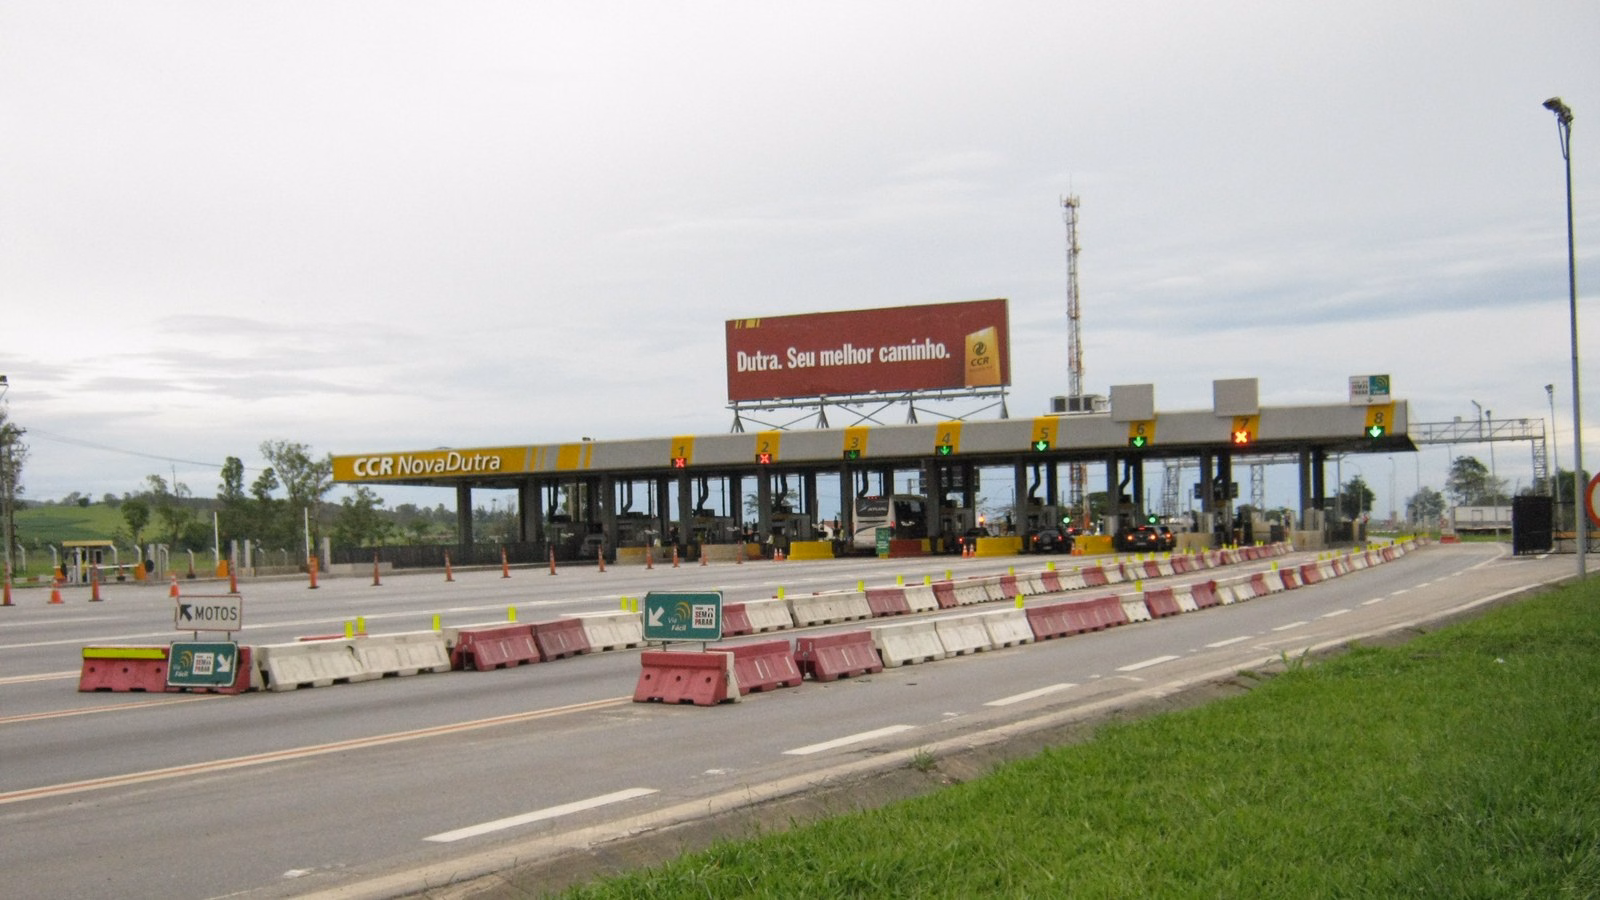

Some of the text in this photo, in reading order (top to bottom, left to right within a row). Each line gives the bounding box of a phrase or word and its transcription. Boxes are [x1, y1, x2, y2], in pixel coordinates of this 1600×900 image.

[737, 338, 951, 372] Dutra. Seu melhor caminho.
[971, 357, 990, 367] CCR
[1240, 416, 1250, 429] 7
[1374, 412, 1384, 424] 8
[1040, 427, 1050, 440] 5
[1136, 423, 1145, 436] 6
[851, 437, 859, 449] 3
[942, 432, 951, 444] 4
[678, 446, 686, 457] 1
[761, 441, 770, 453] 2
[353, 451, 501, 477] CCR NovaDutra
[195, 606, 238, 621] MOTOS
